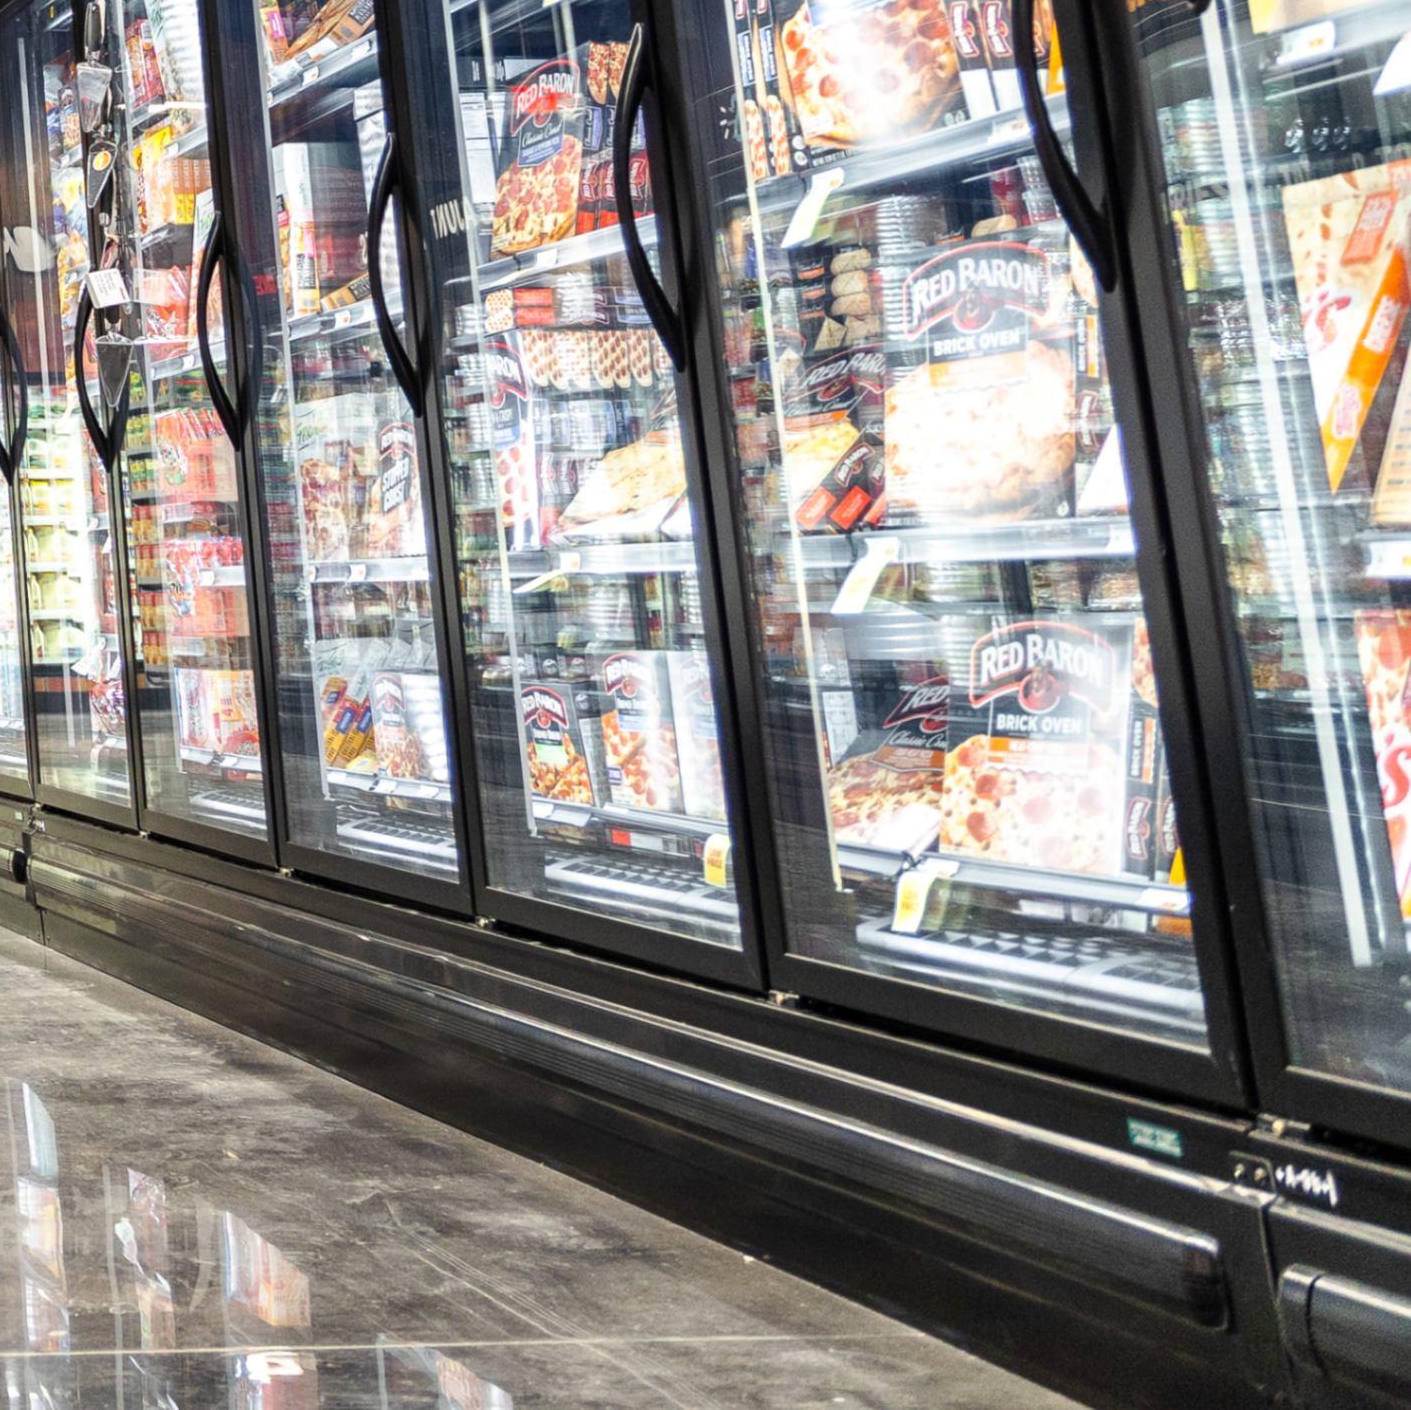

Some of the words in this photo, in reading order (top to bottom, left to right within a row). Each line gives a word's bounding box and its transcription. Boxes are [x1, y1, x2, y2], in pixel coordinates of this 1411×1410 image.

[517, 90, 538, 119] RED
[538, 73, 575, 98] BARON
[913, 271, 956, 318] RED
[958, 257, 1040, 294] BARON
[933, 330, 973, 356] BRICK
[978, 326, 1020, 348] OVEN
[803, 361, 846, 390] RED
[981, 644, 1023, 684] RED
[1027, 635, 1103, 681] BARON
[996, 714, 1037, 732] BRICK
[1041, 714, 1083, 734] OVEN
